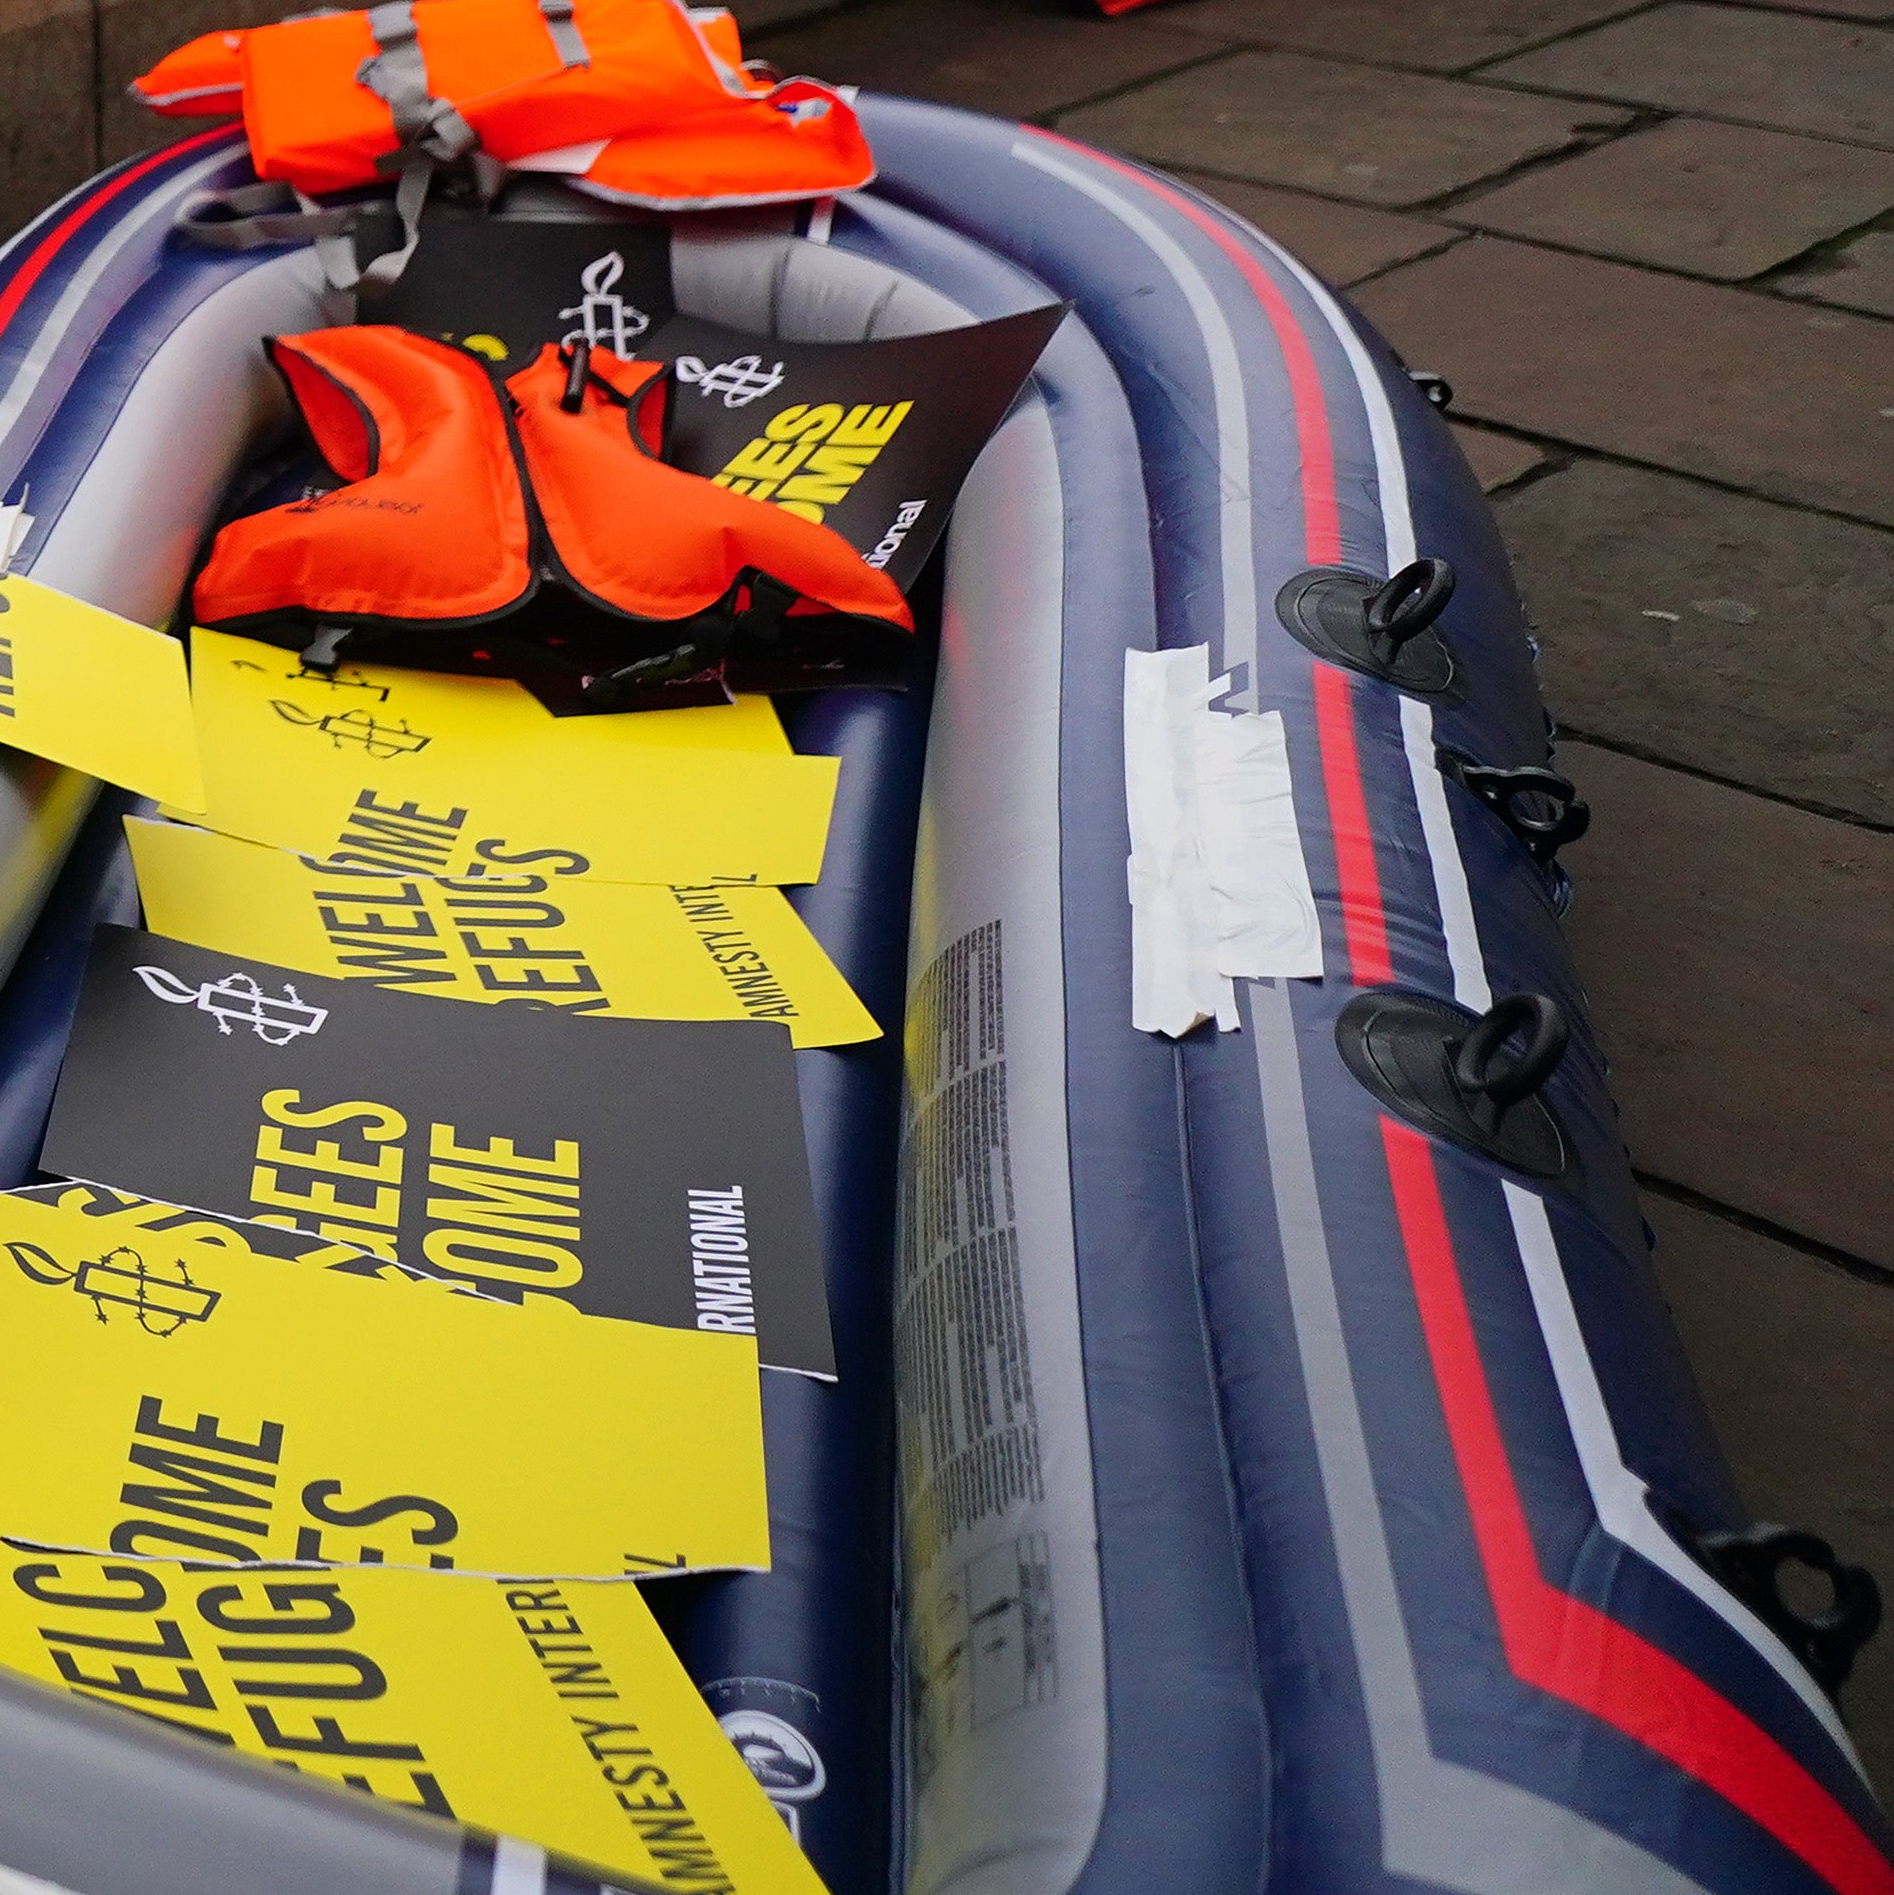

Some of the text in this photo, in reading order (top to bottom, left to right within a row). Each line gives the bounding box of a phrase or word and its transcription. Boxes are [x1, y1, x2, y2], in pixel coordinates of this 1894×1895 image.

[696, 930, 801, 1018] AMNESTY
[496, 1579, 737, 1895] MNESTY INTER
